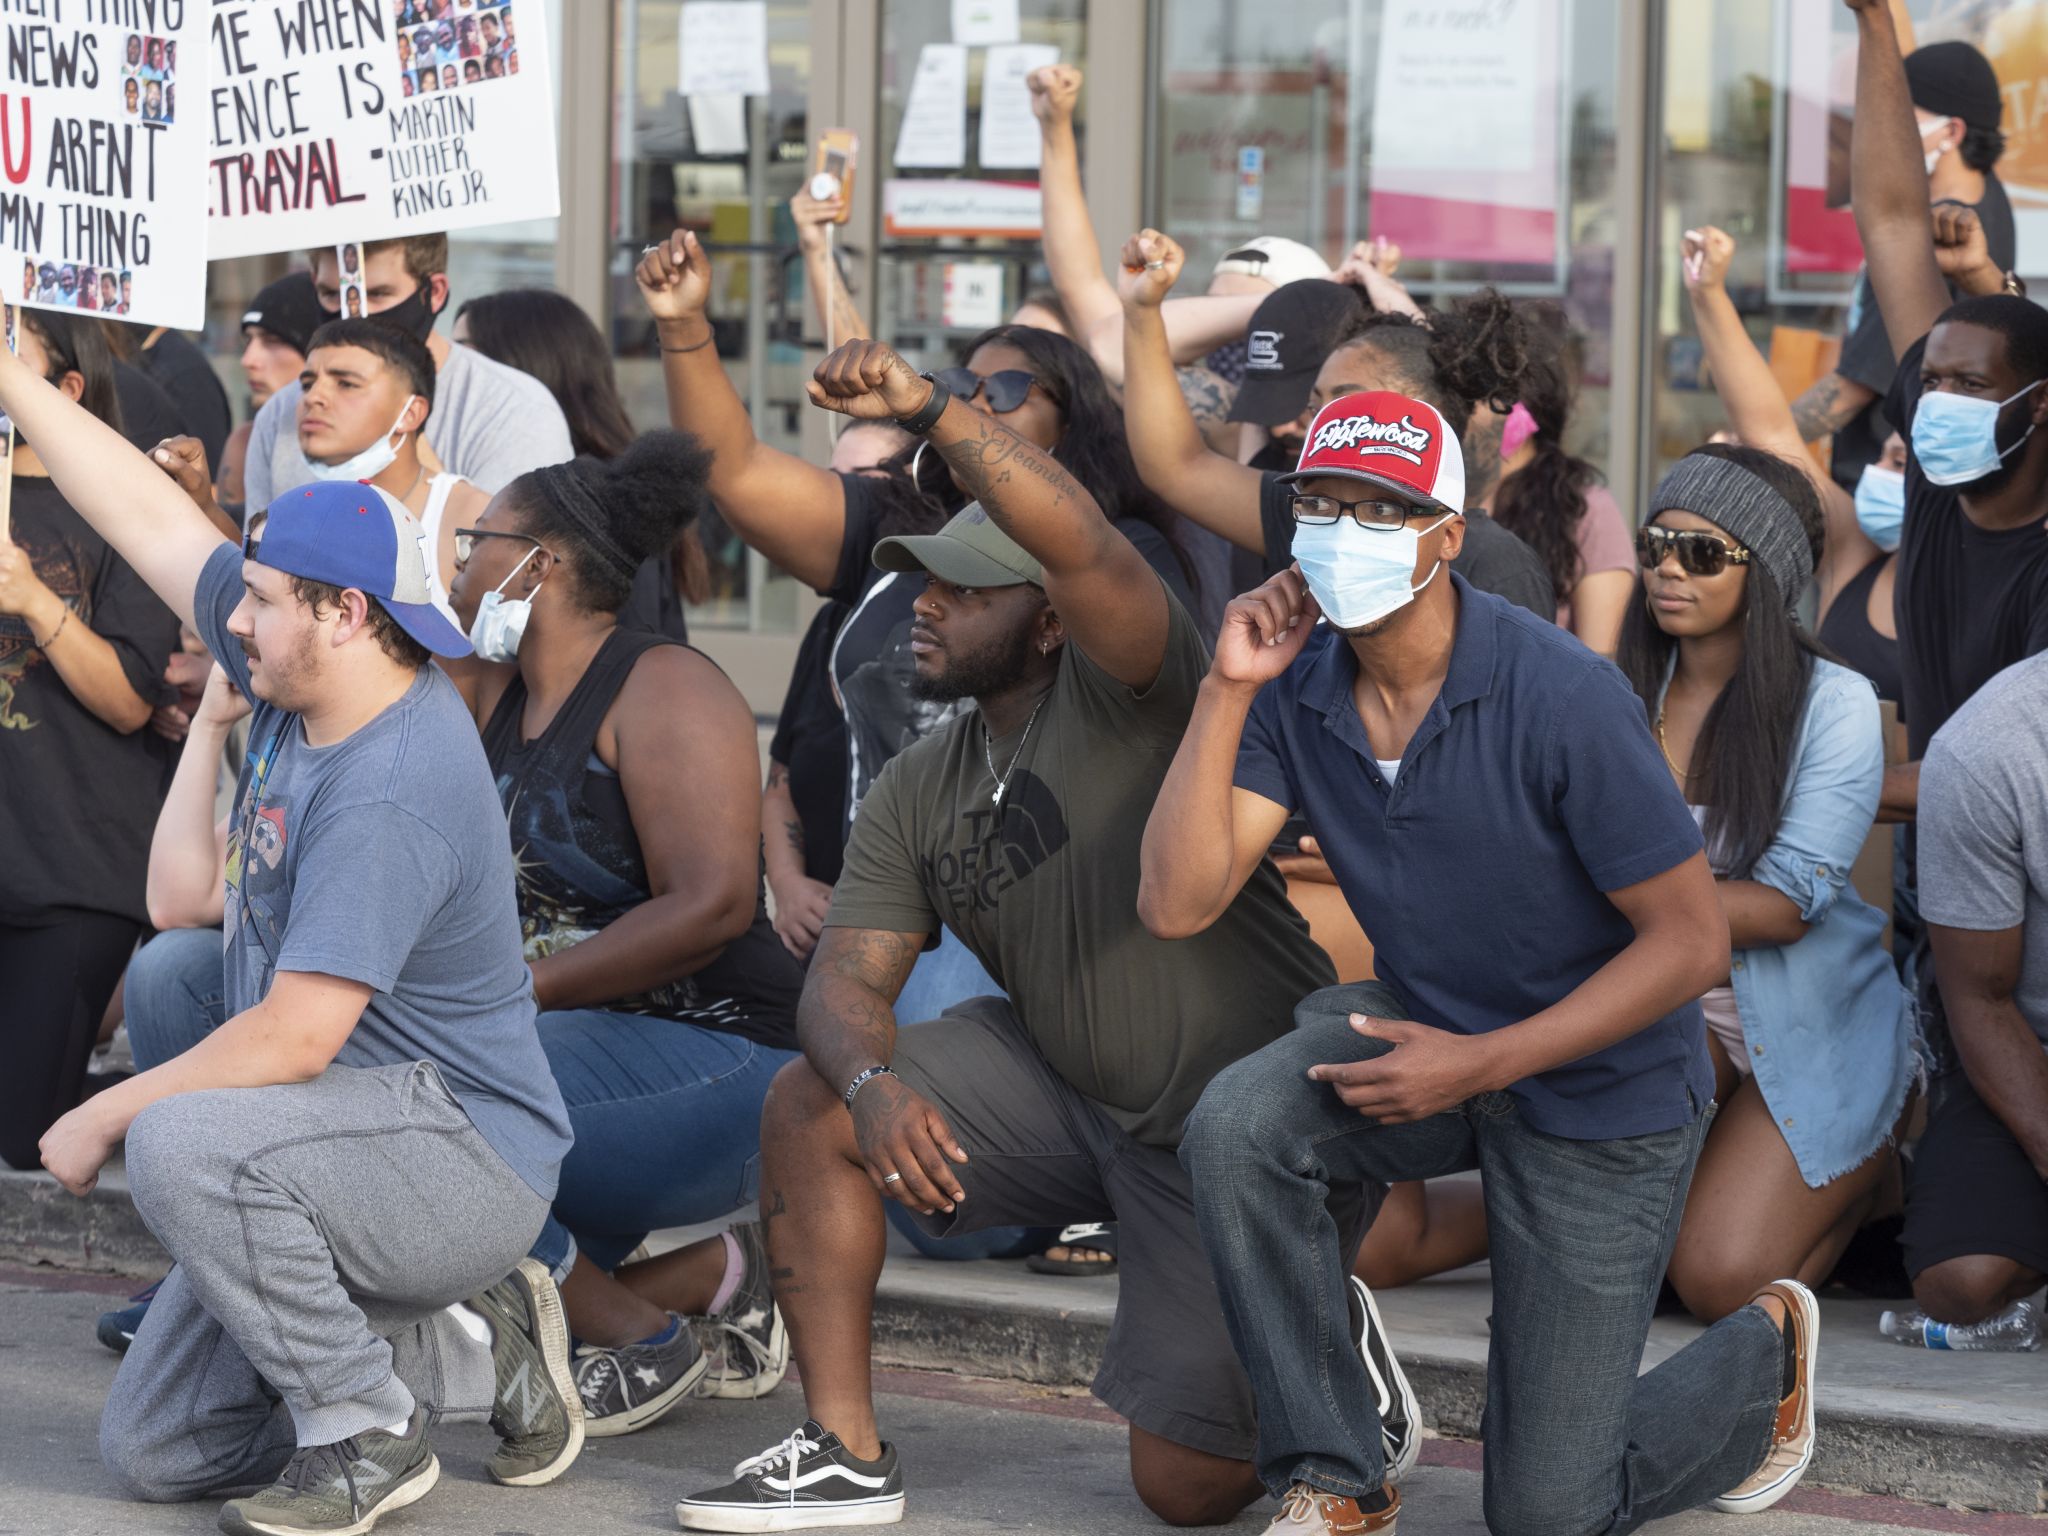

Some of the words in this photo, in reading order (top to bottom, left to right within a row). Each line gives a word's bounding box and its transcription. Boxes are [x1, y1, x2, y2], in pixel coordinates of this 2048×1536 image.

[8, 24, 99, 89] NEWS
[274, 0, 385, 60] WHEN
[210, 71, 310, 147] ENCE
[338, 62, 385, 119] IS
[388, 95, 475, 143] MARTIN
[0, 94, 32, 184] U
[387, 137, 470, 182] LUTHER
[209, 138, 366, 217] TRAYAL
[393, 180, 453, 218] KING
[59, 203, 151, 269] THING
[1308, 415, 1431, 458] Englewood
